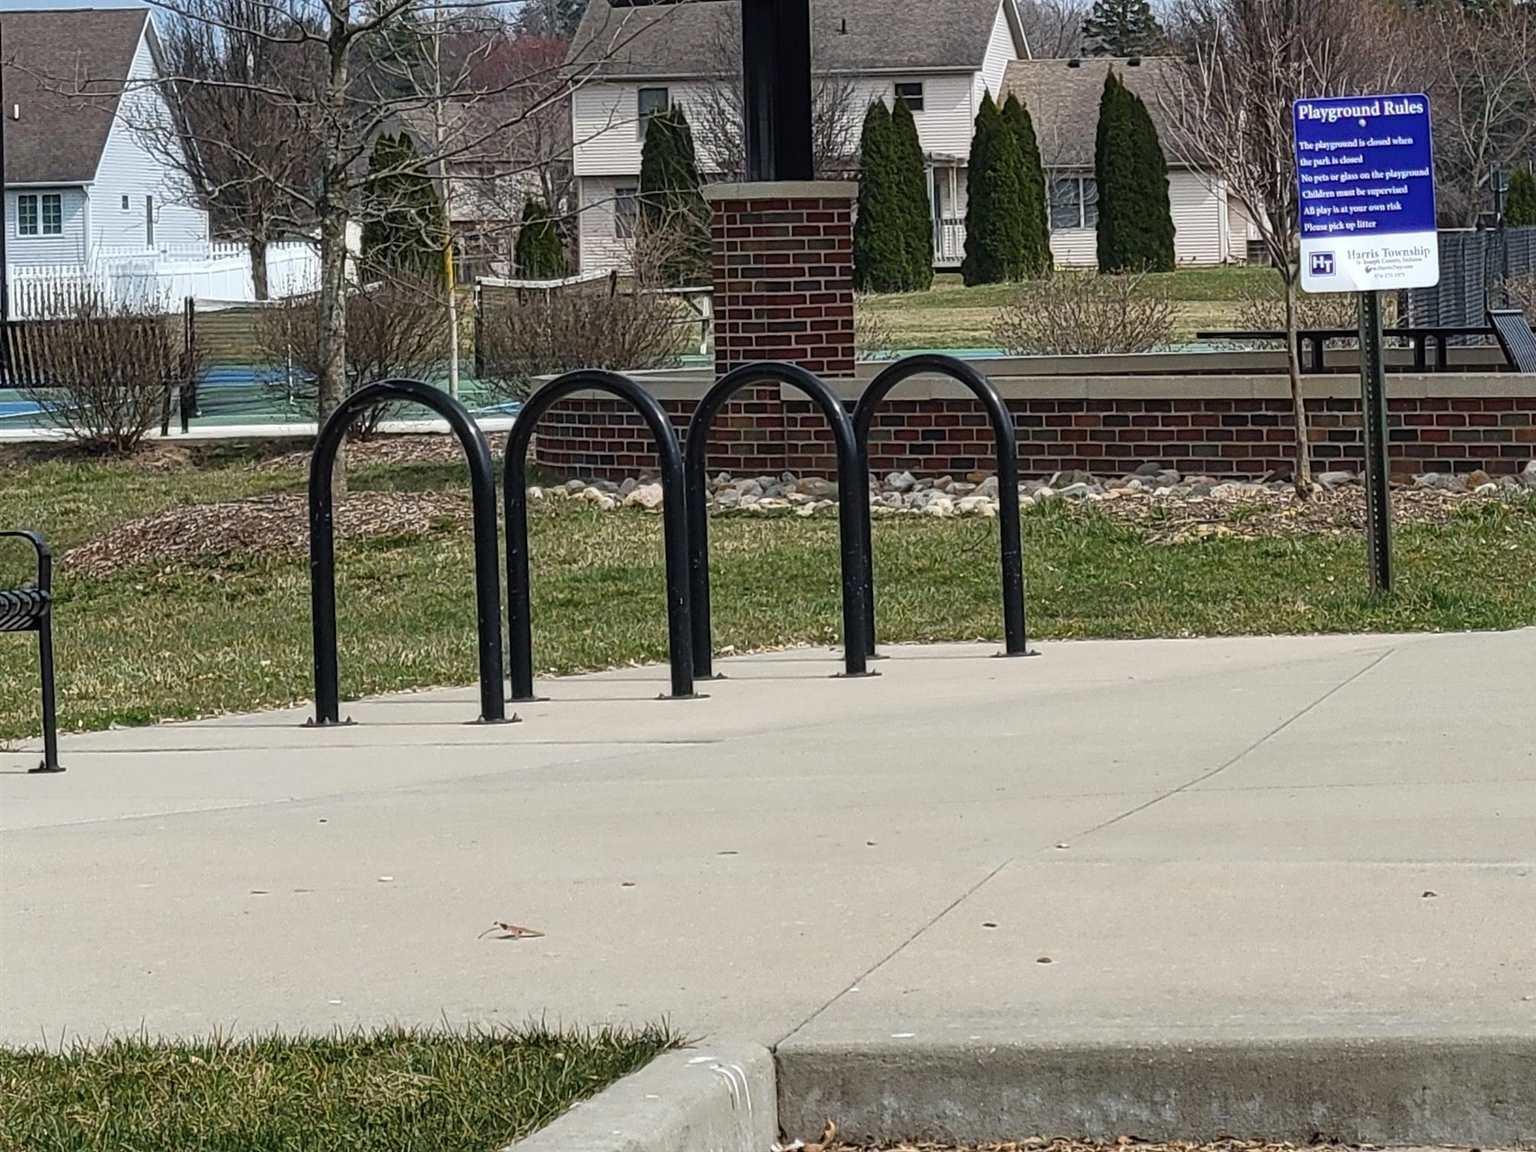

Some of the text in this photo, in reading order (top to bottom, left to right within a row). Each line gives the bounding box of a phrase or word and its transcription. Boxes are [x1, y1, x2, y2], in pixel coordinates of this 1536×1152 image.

[1299, 99, 1423, 122] Playground Rules
[1300, 136, 1413, 150] The playground is closed when
[1300, 155, 1363, 167] the park is closed
[1301, 174, 1313, 182] No
[1314, 174, 1329, 184] pets
[1340, 172, 1358, 182] glass
[1372, 170, 1384, 178] the
[1385, 167, 1429, 180] playground
[1302, 185, 1408, 199] Children must be supervised
[1304, 207, 1315, 215] All
[1316, 205, 1332, 217] play
[1333, 205, 1339, 213] is
[1341, 205, 1348, 213] at
[1349, 205, 1367, 215] your
[1387, 201, 1402, 210] risk
[1304, 220, 1376, 232] Please pick up litter
[1347, 246, 1430, 260] Harris Township
